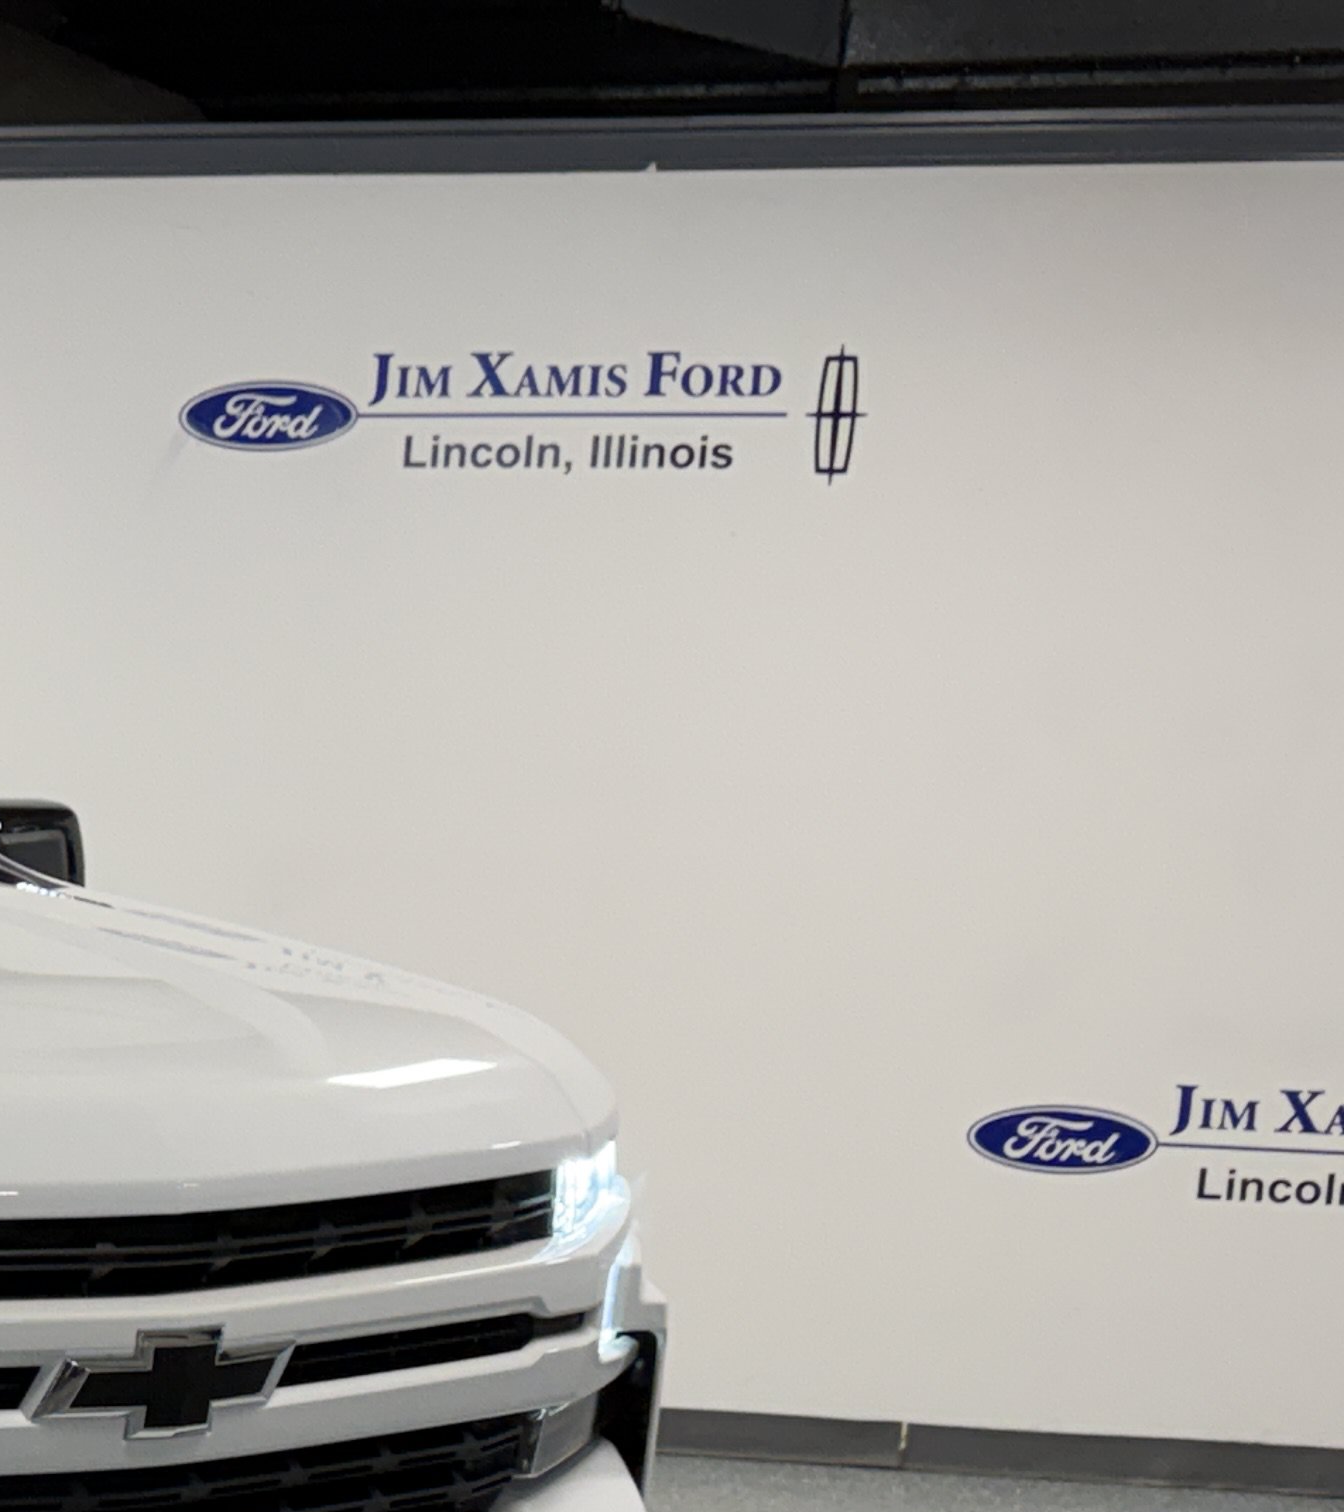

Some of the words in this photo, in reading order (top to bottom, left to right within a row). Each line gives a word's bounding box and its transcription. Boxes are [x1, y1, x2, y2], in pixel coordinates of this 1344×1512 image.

[369, 353, 452, 406] JIM
[467, 352, 628, 398] XAMIS
[647, 352, 781, 398] FORD
[212, 394, 320, 442] Ford
[402, 434, 573, 475] Lincoln,
[589, 434, 733, 470] Illinois
[1169, 1084, 1261, 1136] JIM
[1003, 1115, 1121, 1165] Ford
[1197, 1167, 1344, 1207] Lincol
